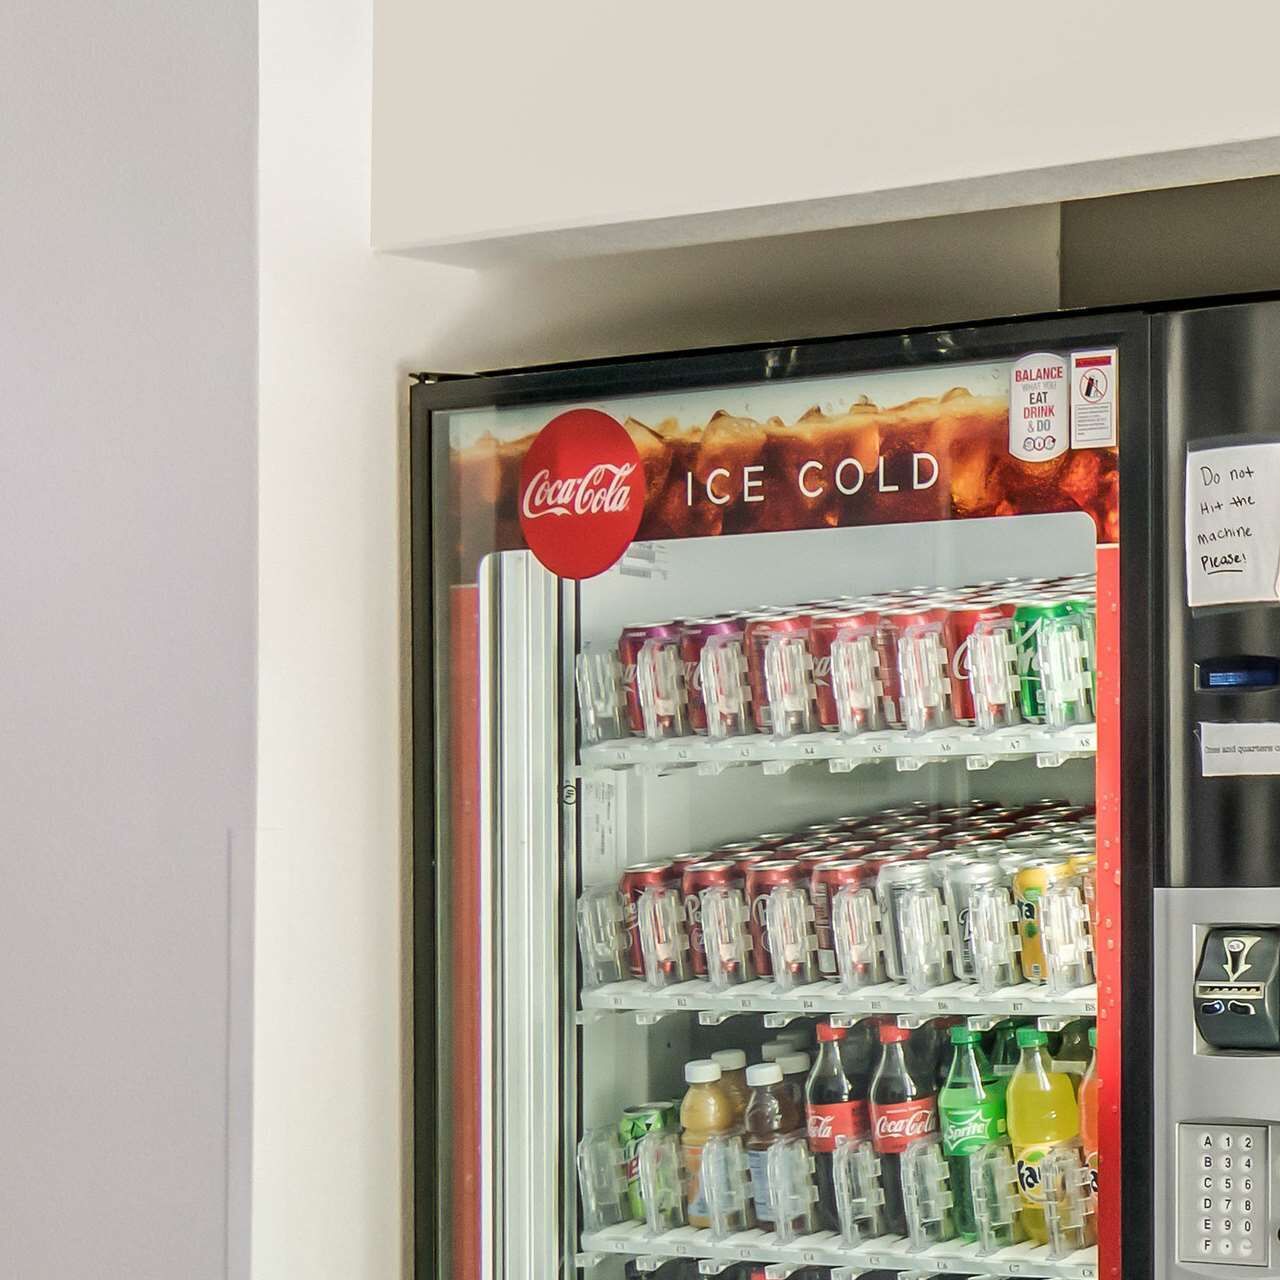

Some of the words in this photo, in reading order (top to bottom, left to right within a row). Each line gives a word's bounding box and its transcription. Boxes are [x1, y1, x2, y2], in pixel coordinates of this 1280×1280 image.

[1015, 366, 1064, 382] BALANCE
[1029, 392, 1048, 405] EAT
[1023, 405, 1055, 419] DRINK
[1027, 422, 1034, 433] &
[1036, 419, 1051, 432] DO
[686, 466, 765, 506] ICE
[798, 452, 940, 498] COLD
[1200, 466, 1220, 486] Do
[1230, 466, 1254, 481] not
[522, 462, 638, 519] Coca-Cola
[1200, 502, 1223, 515] Hit
[1230, 496, 1255, 508] the
[1201, 554, 1246, 572] Please!
[1222, 744, 1236, 753] and
[1238, 745, 1273, 754] quarters
[946, 1121, 986, 1138] Sprite
